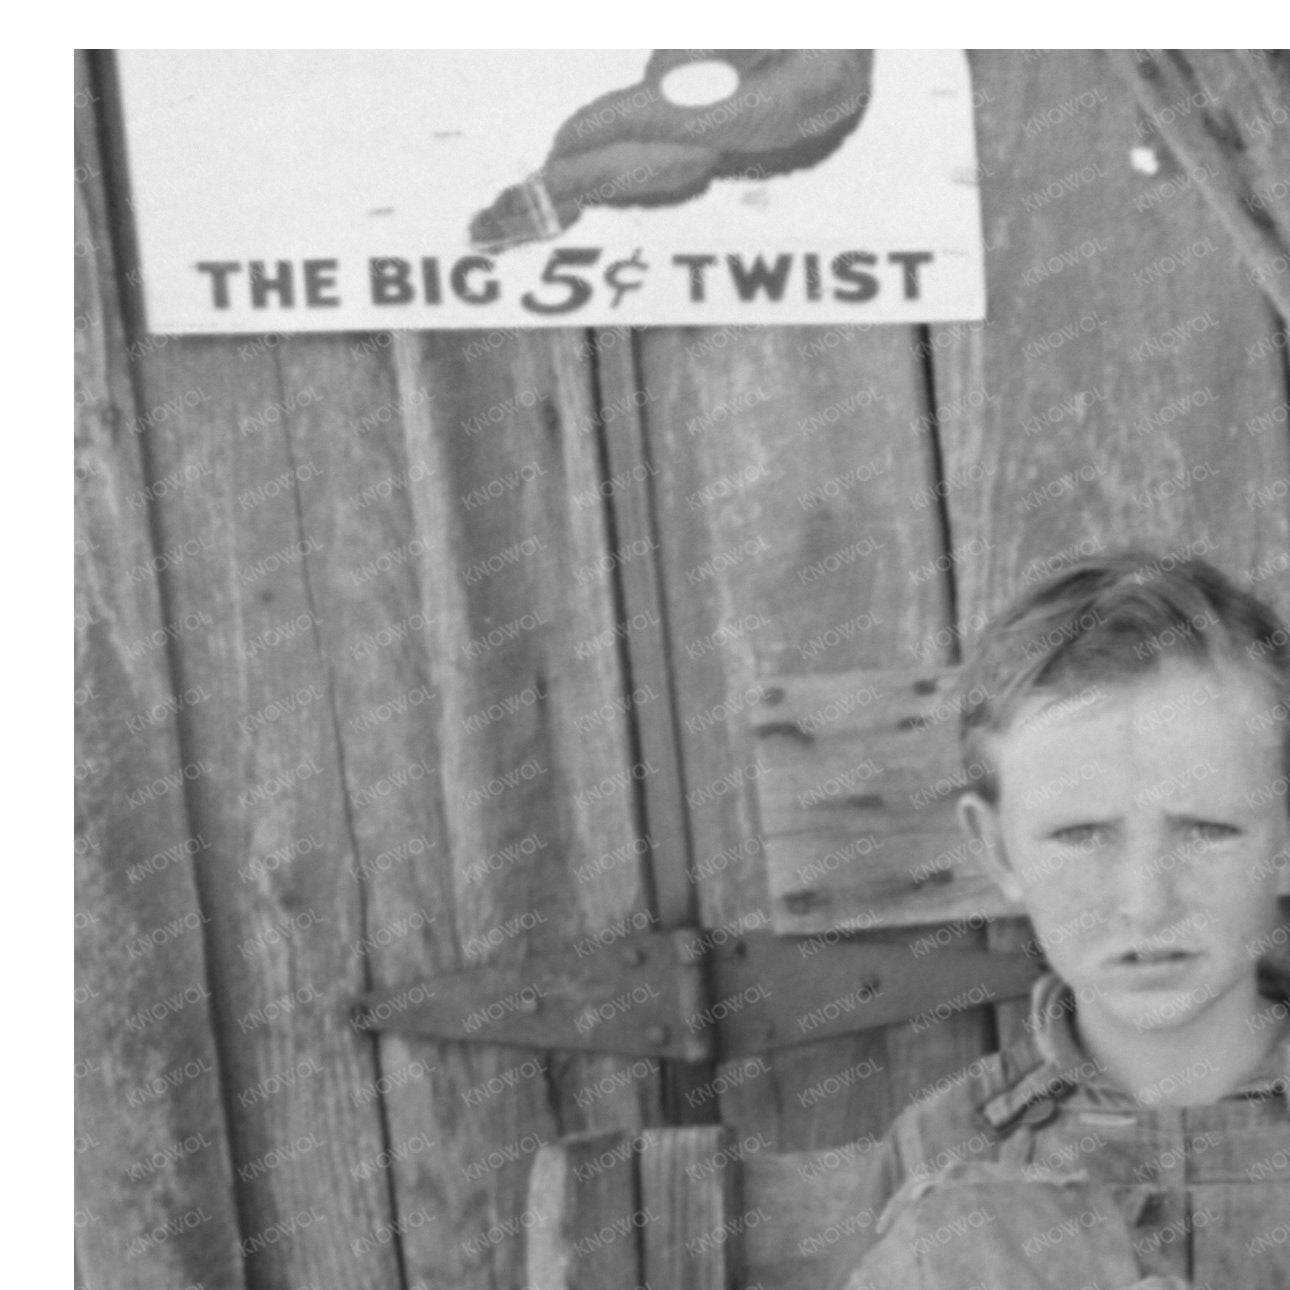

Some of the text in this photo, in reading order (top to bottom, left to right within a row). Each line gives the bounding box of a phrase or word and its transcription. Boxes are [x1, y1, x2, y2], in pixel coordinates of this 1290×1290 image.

[195, 247, 934, 316] THE BIG 5¢ TWIST
